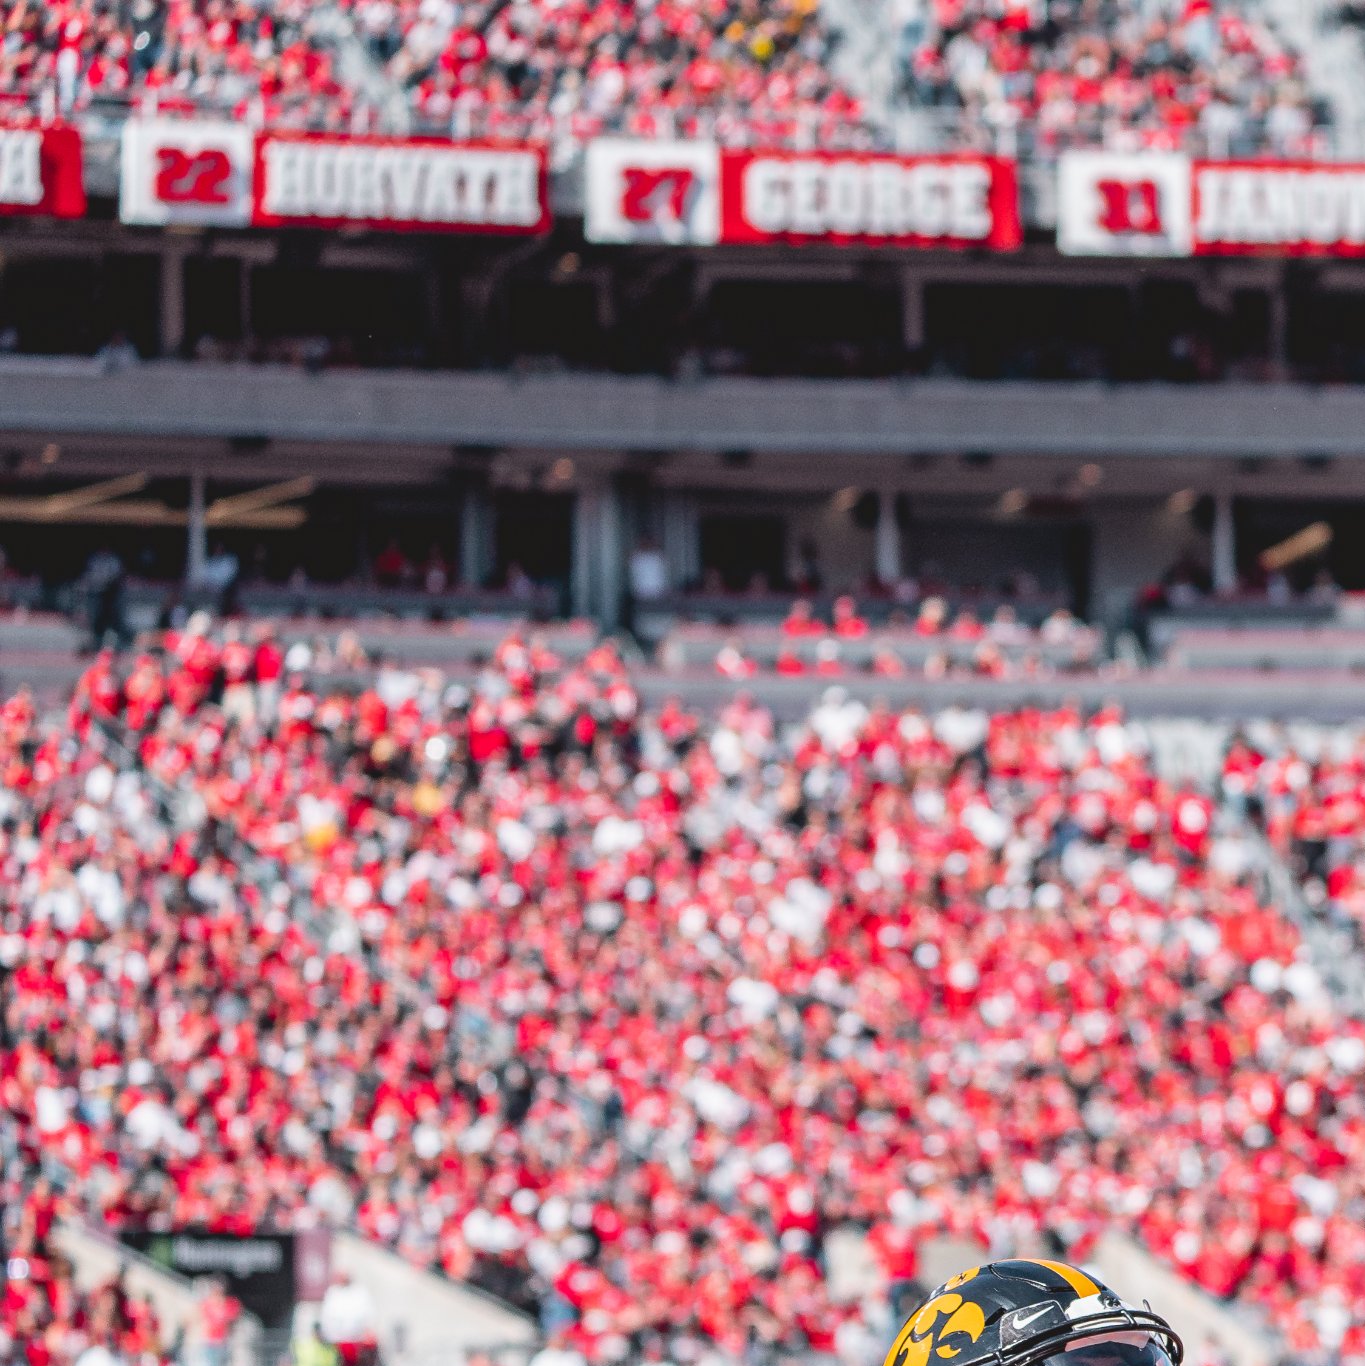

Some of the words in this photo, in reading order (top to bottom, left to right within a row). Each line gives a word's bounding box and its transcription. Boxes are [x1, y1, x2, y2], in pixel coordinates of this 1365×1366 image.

[158, 148, 230, 203] 22
[263, 139, 541, 226] HORVATH
[622, 167, 692, 220] 27
[743, 159, 992, 239] GEORGE
